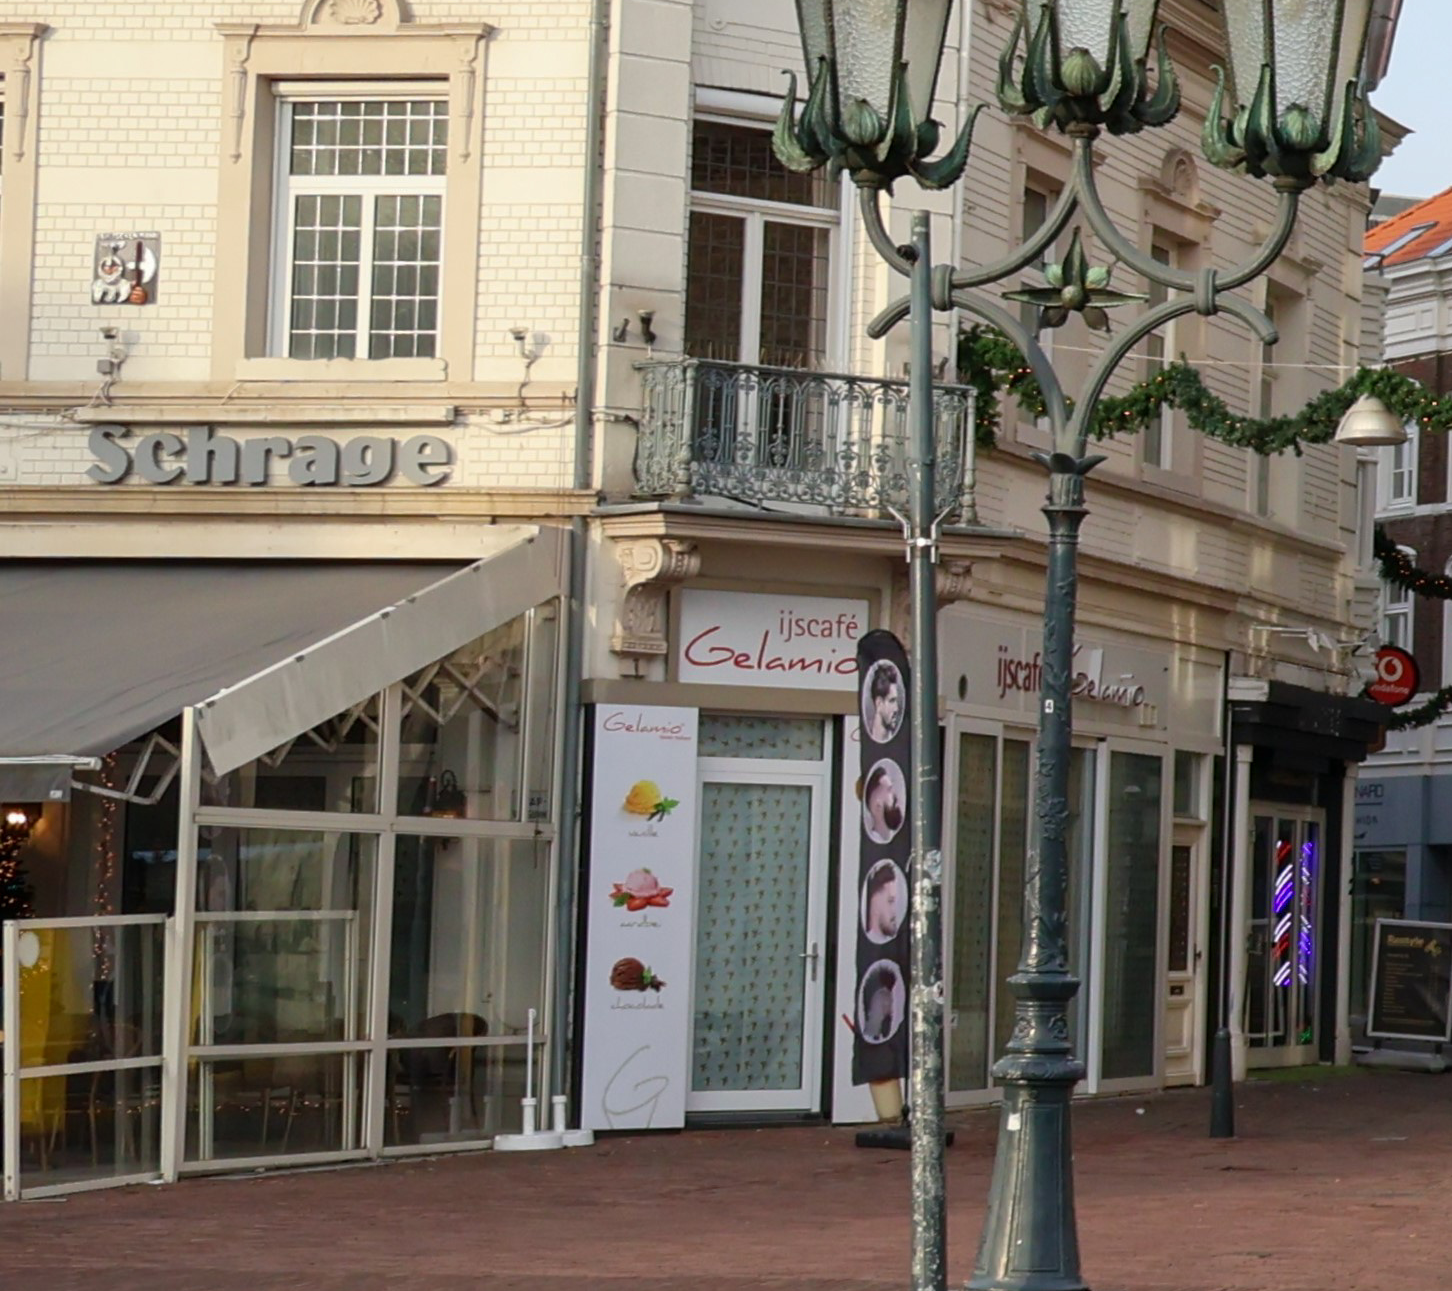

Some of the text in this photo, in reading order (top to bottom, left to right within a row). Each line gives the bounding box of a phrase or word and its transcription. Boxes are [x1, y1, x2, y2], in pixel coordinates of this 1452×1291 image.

[85, 424, 454, 486] Schrage
[684, 626, 859, 675] Gelamio
[779, 610, 858, 642] ijscafé
